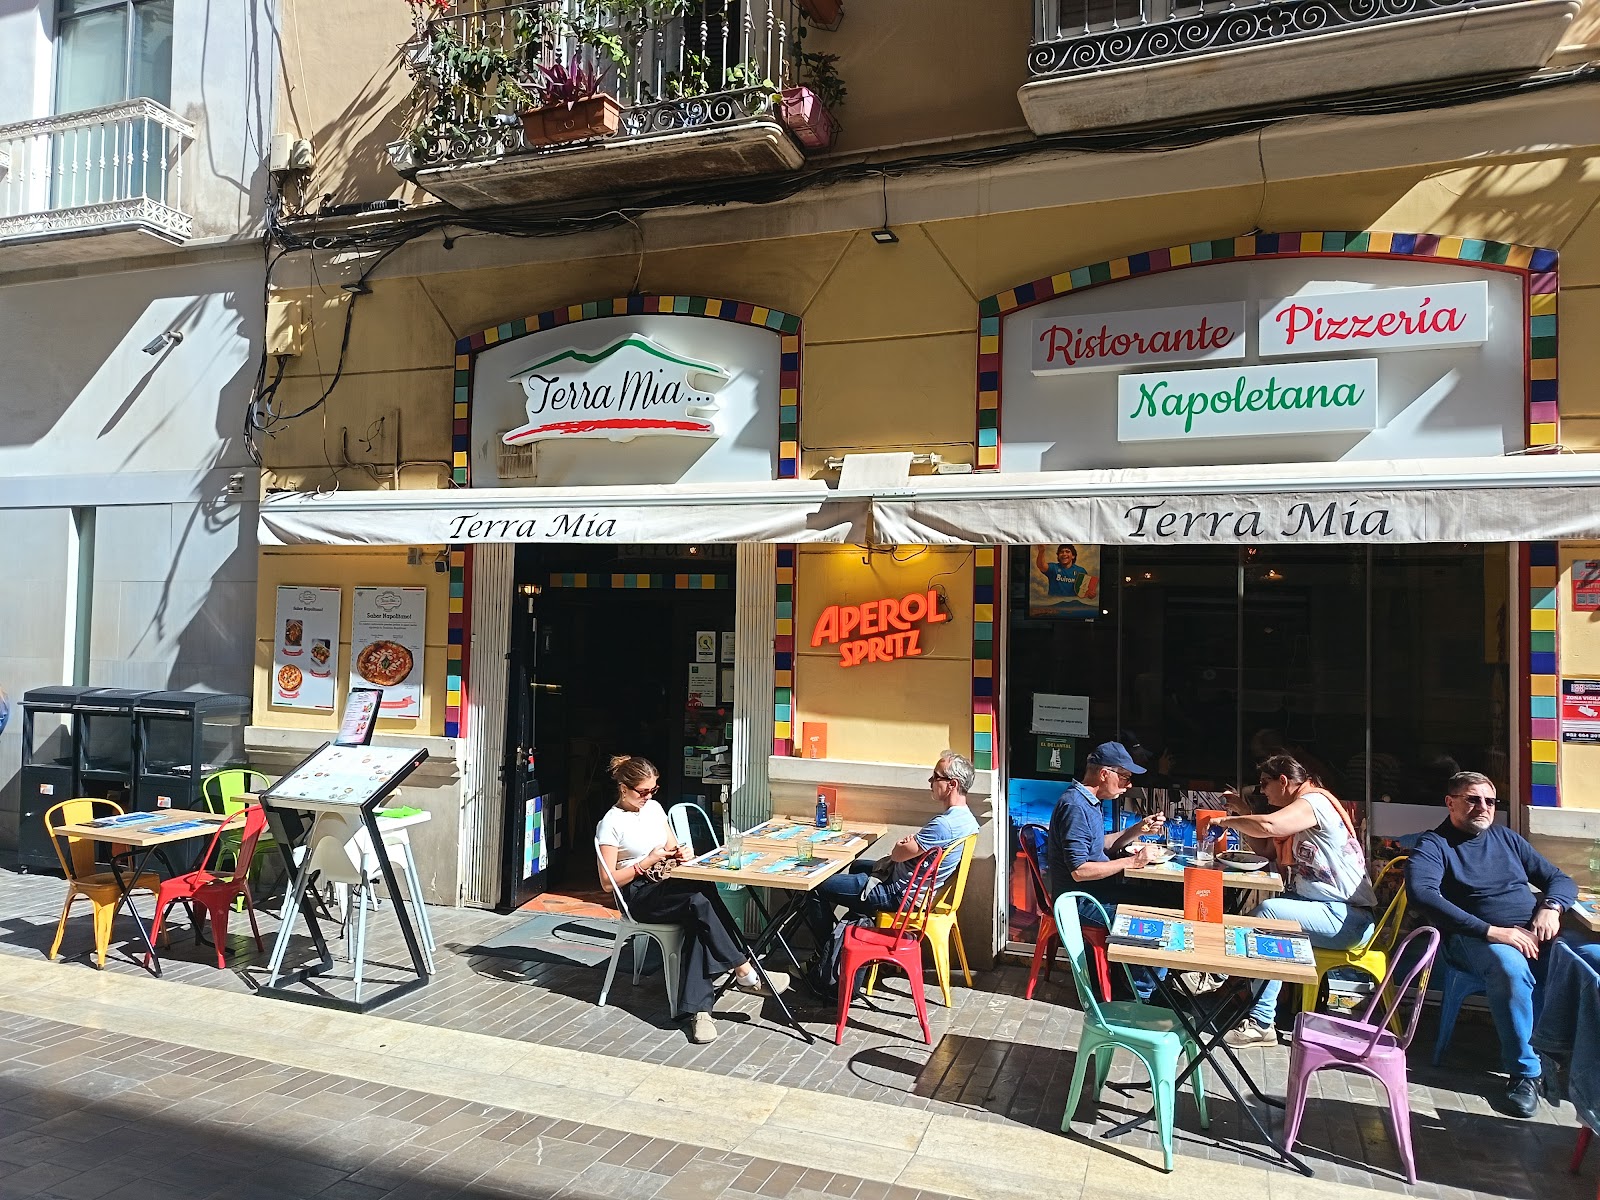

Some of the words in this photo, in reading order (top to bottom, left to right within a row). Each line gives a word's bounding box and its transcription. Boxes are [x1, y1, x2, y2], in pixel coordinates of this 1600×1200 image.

[1039, 316, 1235, 366] Ristorante
[1275, 297, 1466, 345] Pizzería
[528, 374, 615, 414] Terra
[1130, 376, 1365, 433] Napoletana
[449, 512, 536, 538] Terra
[1124, 500, 1265, 537] Terra
[811, 590, 947, 647] APEROL
[839, 629, 922, 668] SPRITZ
